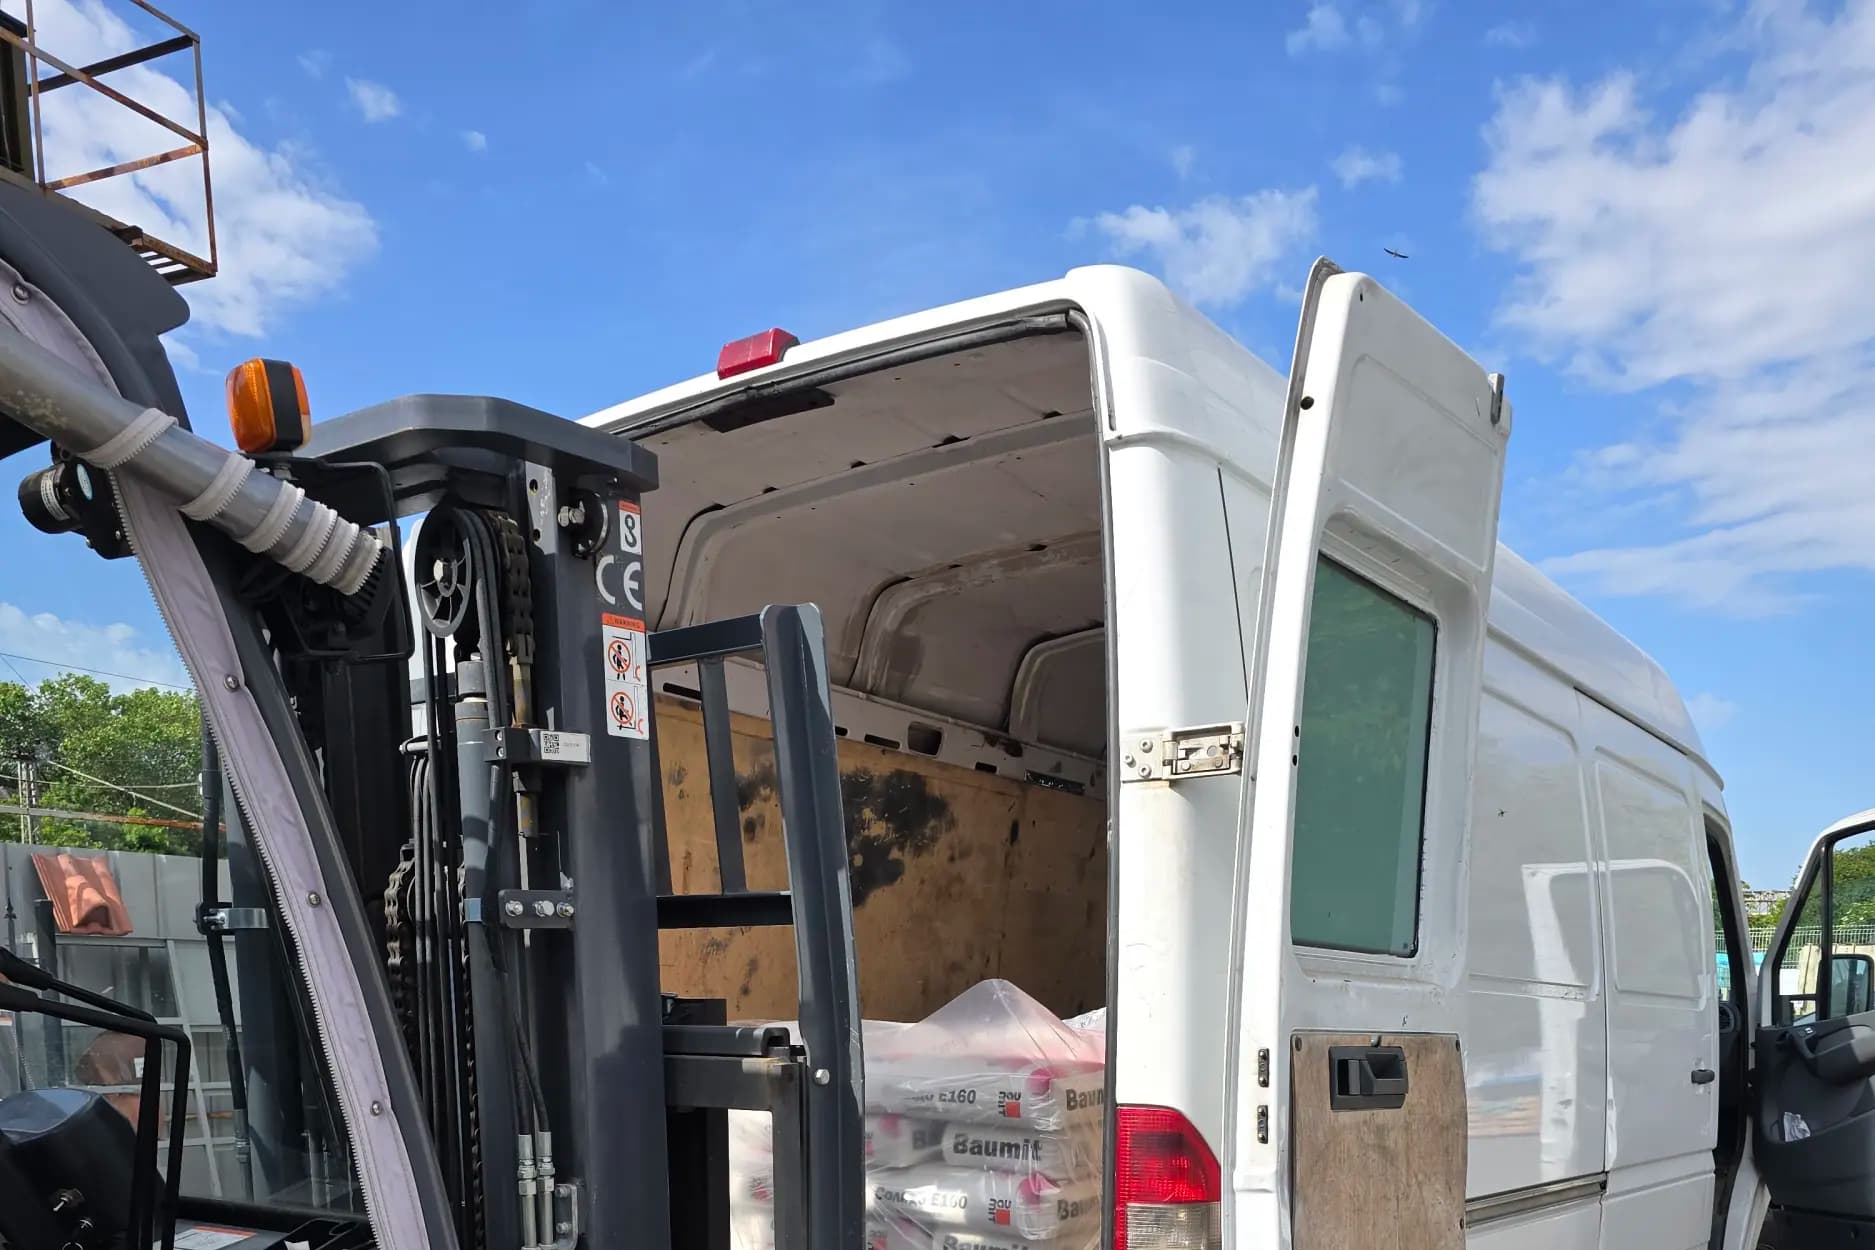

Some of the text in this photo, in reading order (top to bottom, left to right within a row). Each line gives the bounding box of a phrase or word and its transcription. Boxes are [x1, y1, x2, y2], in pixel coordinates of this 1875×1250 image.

[596, 554, 643, 611] CE
[939, 1089, 977, 1104] E160
[953, 1132, 1042, 1161] Baumit
